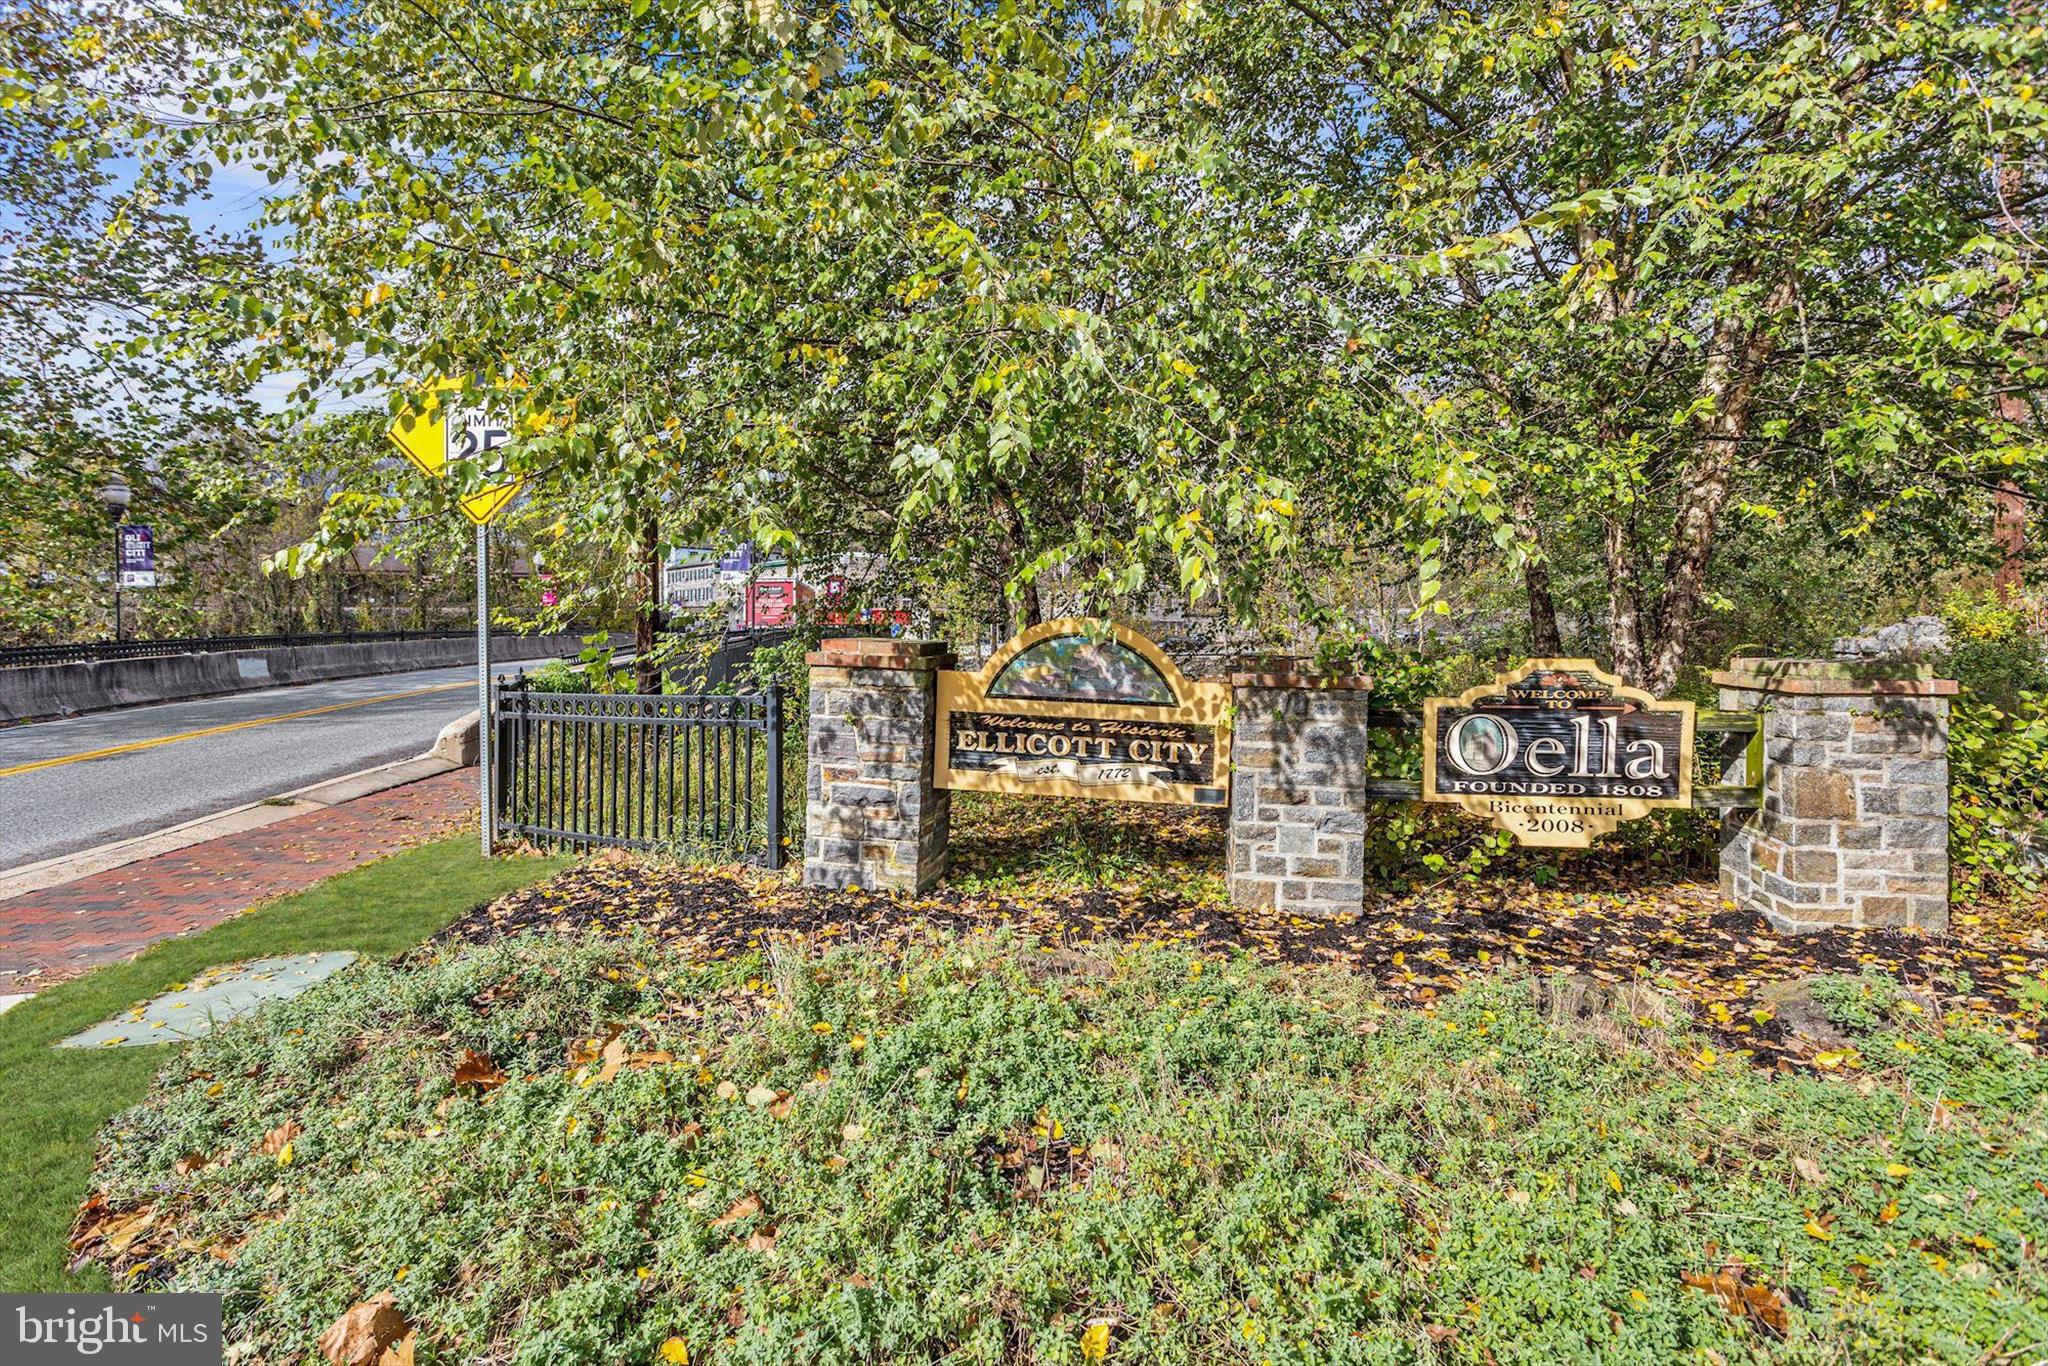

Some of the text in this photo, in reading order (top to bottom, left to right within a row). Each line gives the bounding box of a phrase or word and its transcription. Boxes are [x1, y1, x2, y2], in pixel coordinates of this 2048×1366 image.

[1511, 689, 1607, 699] WELCOME
[1545, 700, 1572, 709] TO
[980, 714, 1187, 738] Welcome to Historic
[956, 729, 1208, 765] ELLICOTT CITY
[1445, 714, 1670, 780] Oella
[1036, 764, 1131, 780] est. 1772
[1452, 781, 1663, 797] FOUNDED 1808
[1489, 801, 1623, 816] Bicentennial
